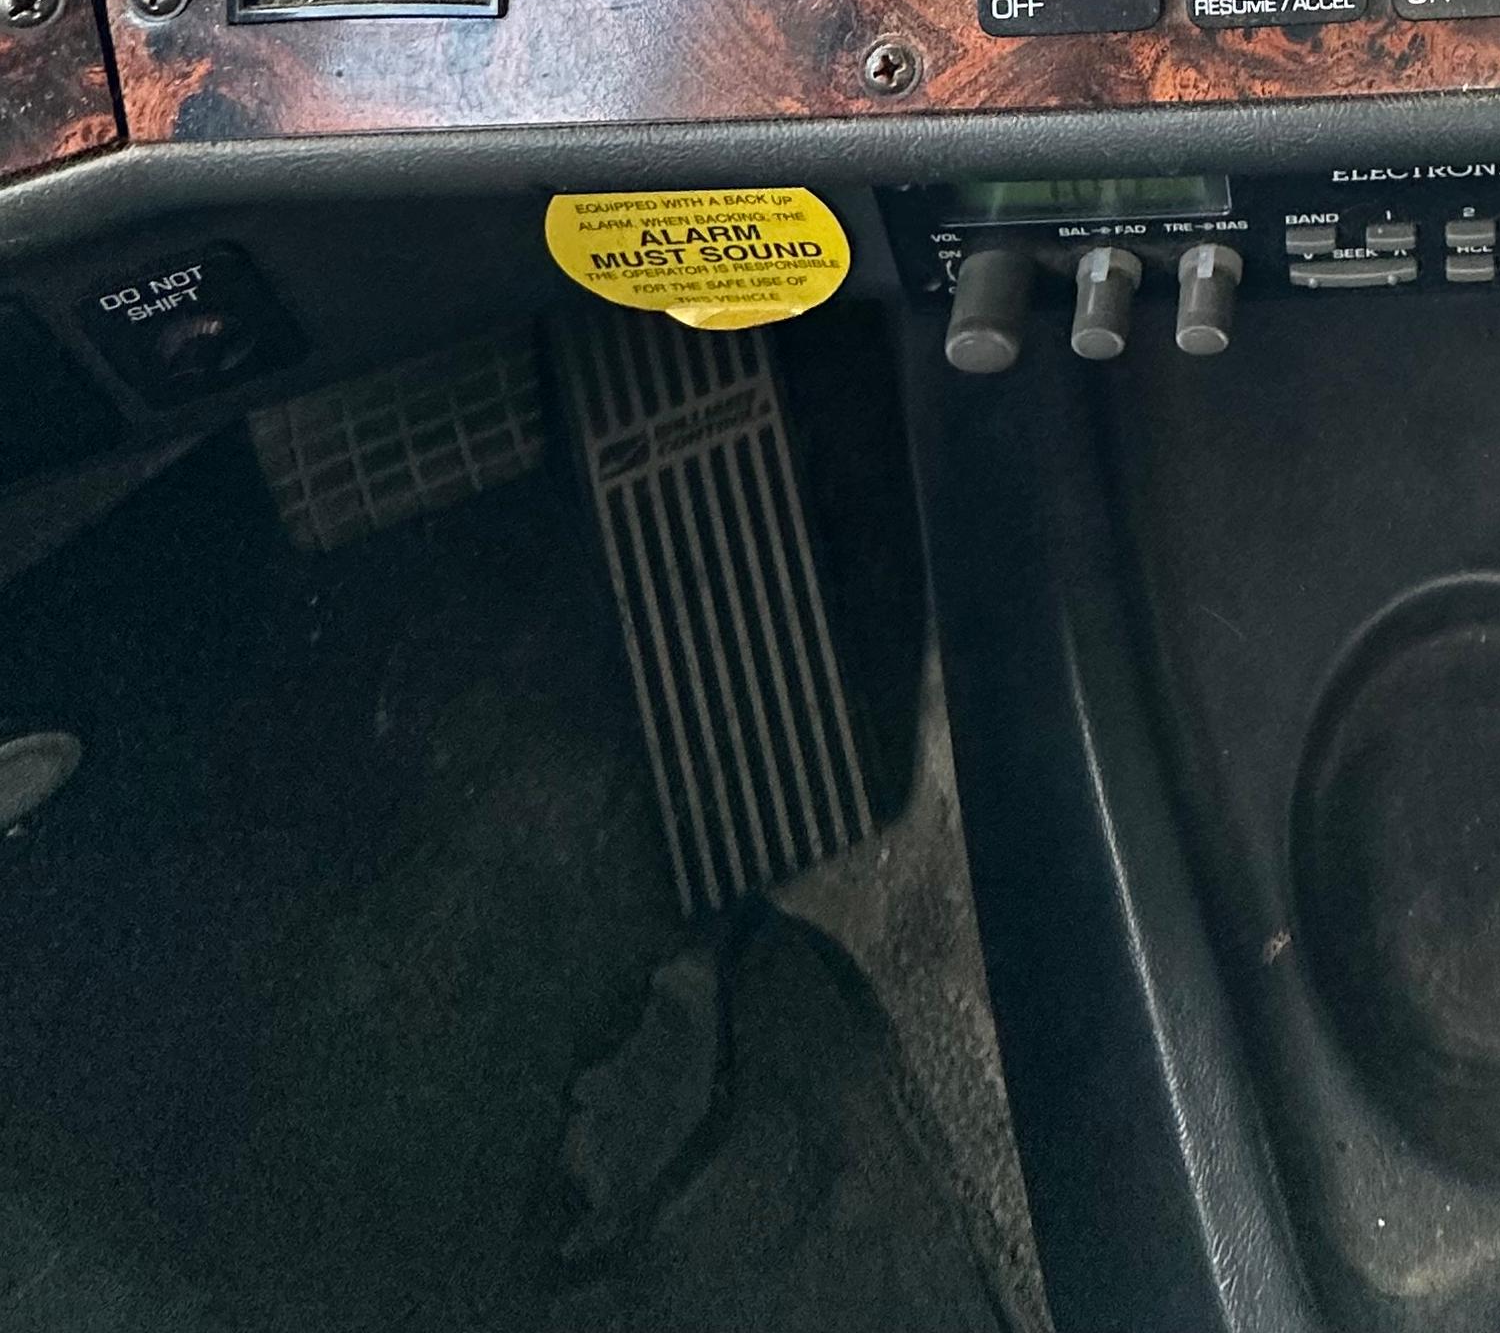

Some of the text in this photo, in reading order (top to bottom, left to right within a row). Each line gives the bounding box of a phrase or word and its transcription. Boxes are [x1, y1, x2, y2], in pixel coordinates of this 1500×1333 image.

[575, 194, 792, 213] EQUIPPED WITH A BACK UP
[640, 216, 690, 227] WHEN
[773, 211, 806, 221] THE
[1285, 213, 1339, 225] BAND
[1385, 210, 1392, 220] 1
[1463, 207, 1476, 217] 2
[641, 224, 761, 246] ALARM
[1059, 224, 1146, 236] BAL FAD
[1163, 221, 1249, 233] TRE BAS
[930, 234, 961, 242] VOL
[591, 242, 822, 269] MUST SOUND
[939, 250, 961, 259] ON
[1333, 248, 1378, 258] SEEK
[586, 260, 840, 281] THE OPERATOR IS RESPONSIBLE
[99, 265, 202, 311] DO NOT
[633, 276, 807, 293] FOR THE SAFE USE OF
[127, 287, 198, 321] SHIFT
[714, 293, 781, 303] VEHICLE
